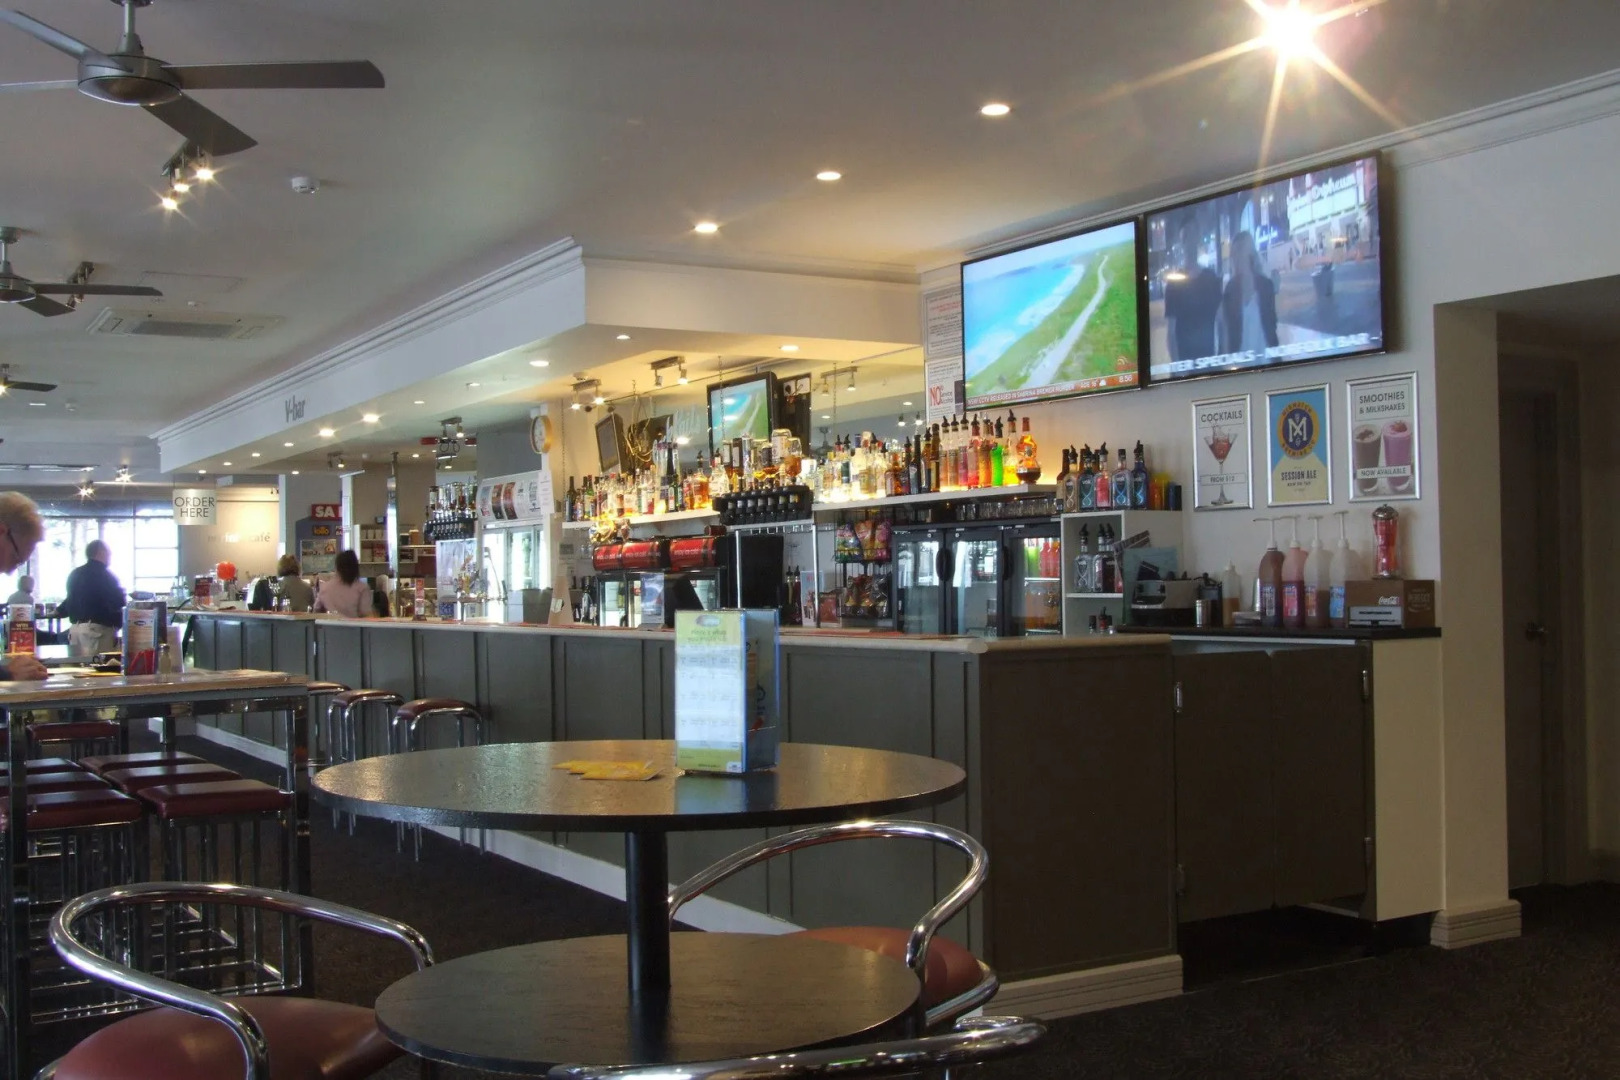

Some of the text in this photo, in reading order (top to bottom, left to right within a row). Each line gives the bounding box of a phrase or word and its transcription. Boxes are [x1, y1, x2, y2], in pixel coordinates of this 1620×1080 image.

[1195, 350, 1254, 370] SPECIALS
[1338, 333, 1370, 347] BAR
[1118, 375, 1133, 383] 8:56
[1359, 391, 1405, 404] SMOOTHIES
[1366, 403, 1406, 414] MILKSHAKES
[1201, 410, 1243, 423] COCKTAILS
[1281, 470, 1317, 481] SESSION ALE
[1377, 467, 1407, 475] AVAILABLE
[1210, 476, 1225, 484] FROM
[174, 496, 215, 508] ORDER
[180, 507, 209, 518] HERE
